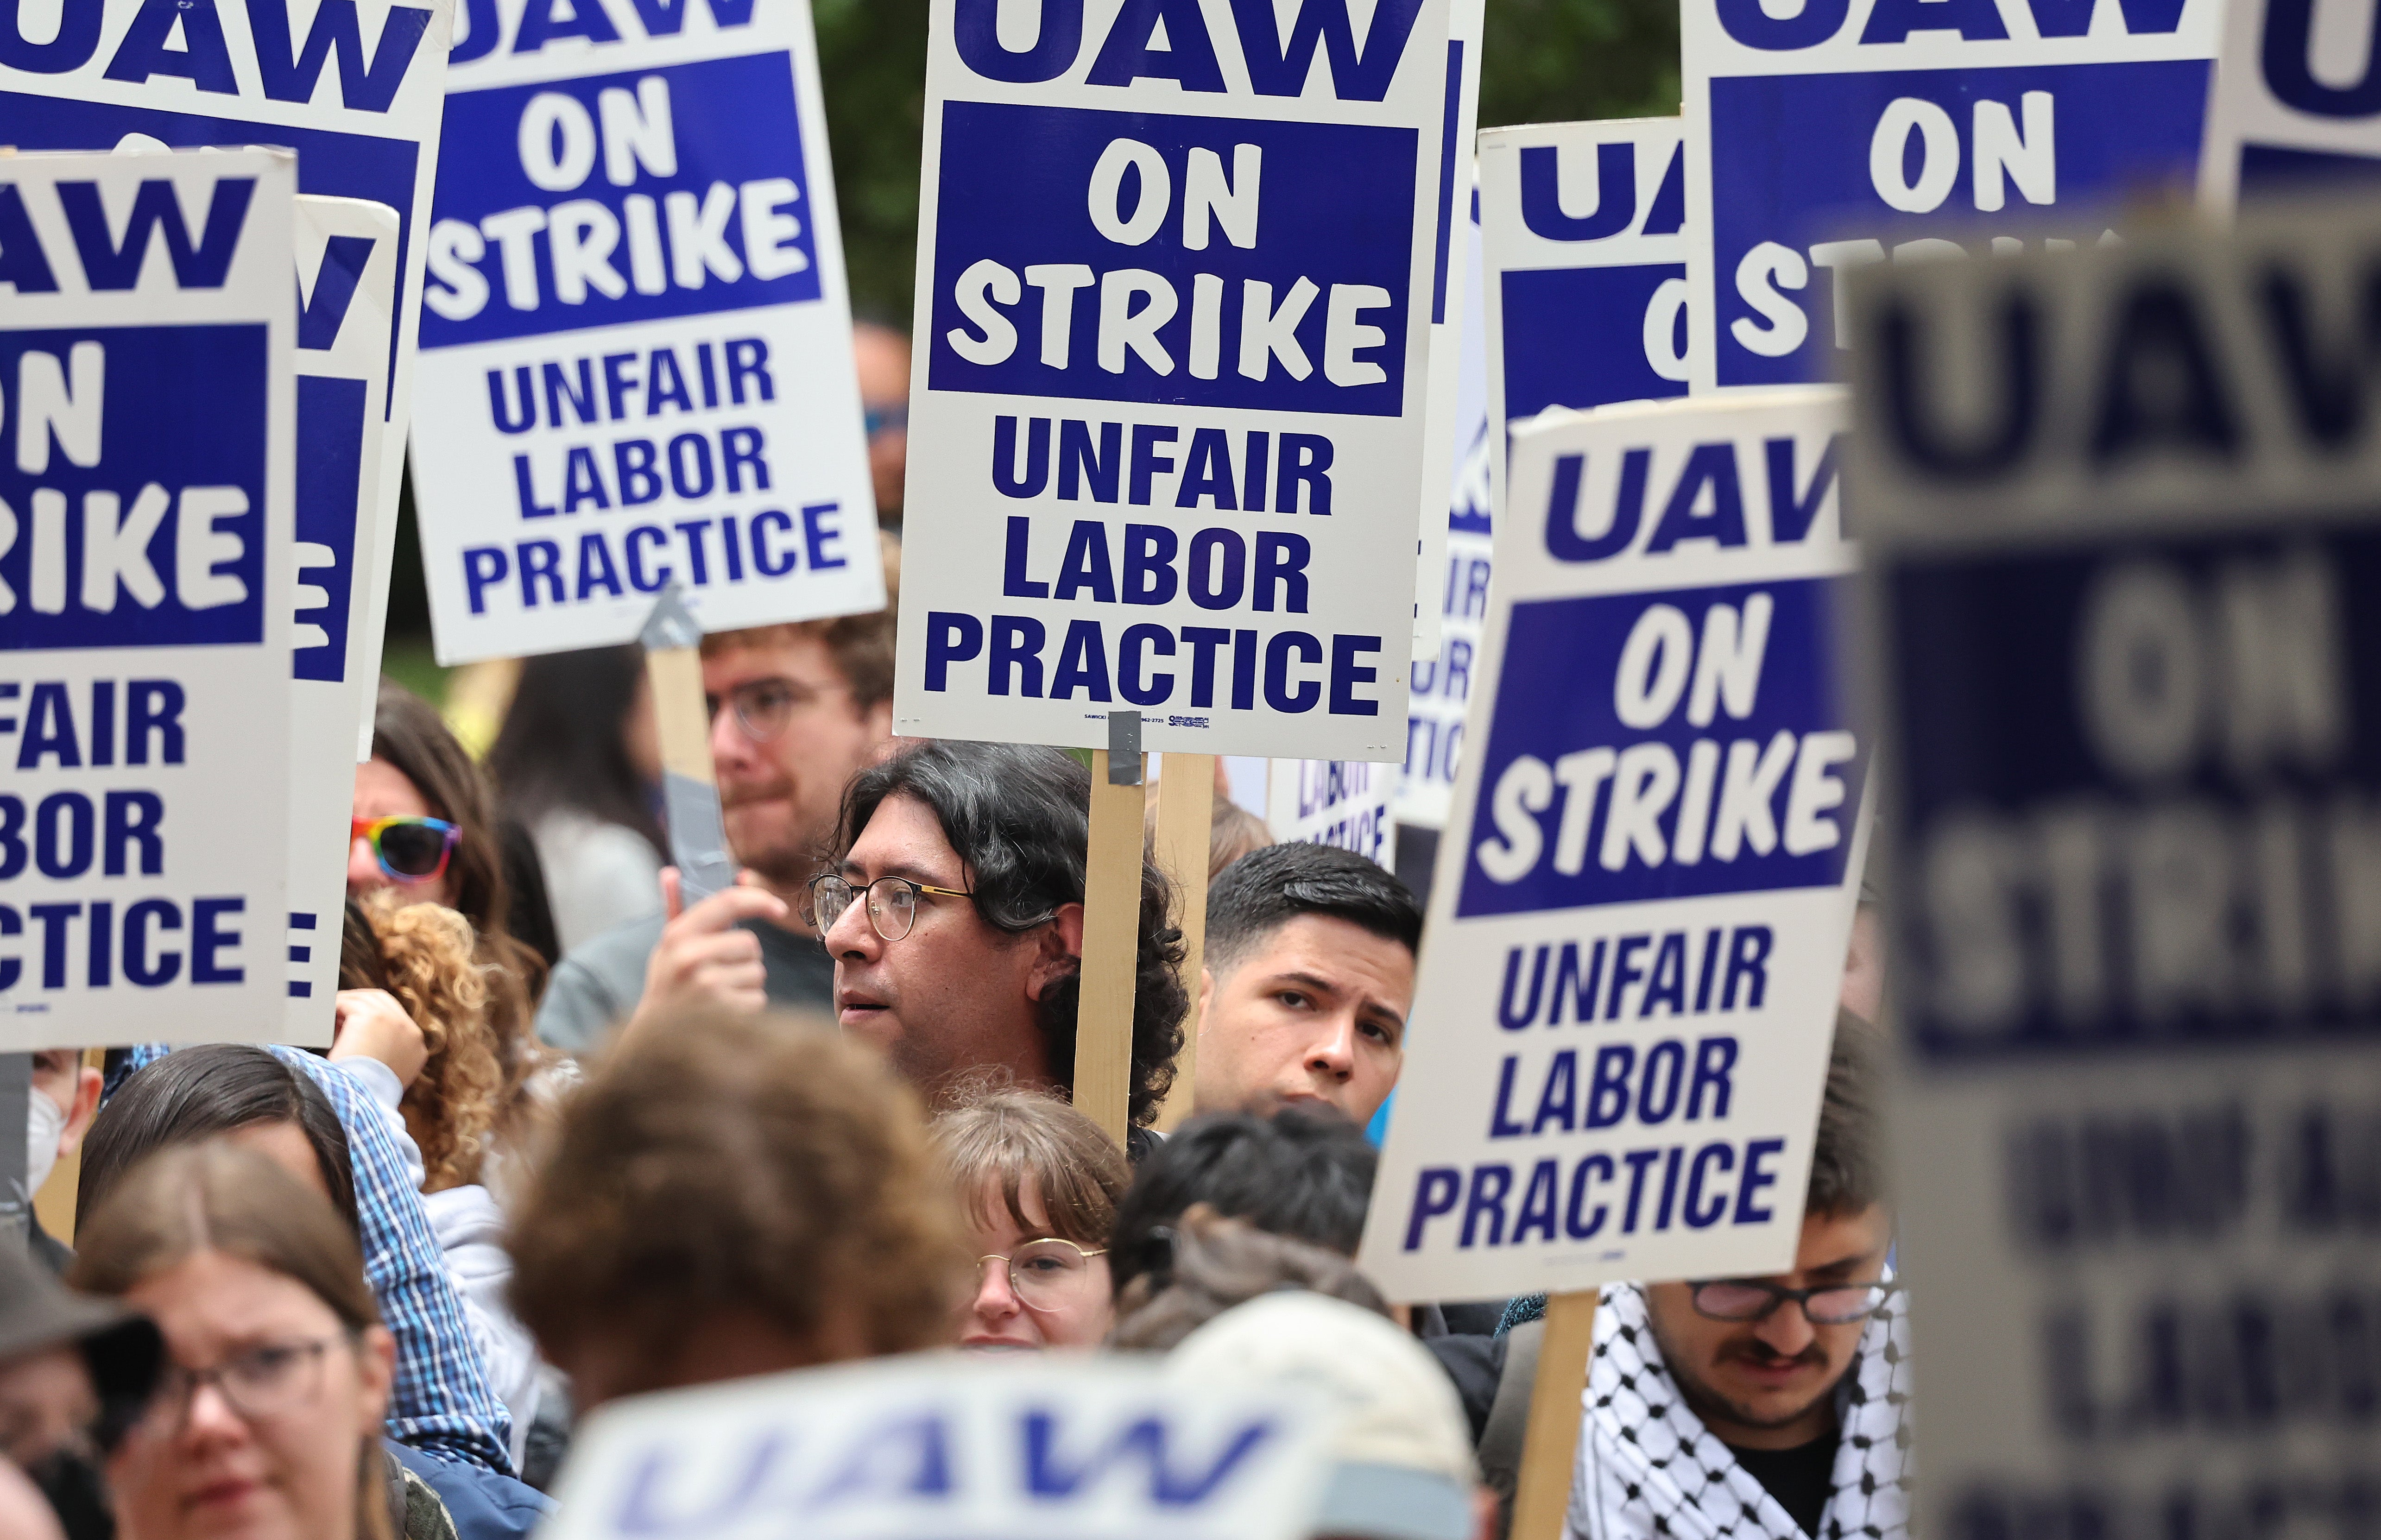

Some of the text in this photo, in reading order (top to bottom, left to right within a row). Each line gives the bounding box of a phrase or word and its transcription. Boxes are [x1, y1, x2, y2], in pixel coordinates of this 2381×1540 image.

[954, 0, 1421, 101] UAW
[518, 76, 677, 191] ON
[1869, 90, 2056, 214] ON
[423, 177, 808, 320] STRIKE
[1088, 138, 1262, 250] ON
[946, 259, 1391, 387] STRIKE
[0, 341, 105, 474] N
[487, 336, 774, 435] UNFAIR
[513, 425, 772, 520] LABOR
[992, 415, 1334, 516] UNFAIR
[464, 501, 846, 615] PRACTICE
[1003, 515, 1311, 613] LABOR
[924, 611, 1382, 716] PRACTICE
[1615, 592, 1774, 729] ON
[0, 790, 164, 880] BOR
[1477, 729, 1855, 884] STRIKE
[1497, 925, 1774, 1030] UNFAIR
[1489, 1036, 1738, 1139] LABOR
[1402, 1137, 1785, 1254] PRACTICE
